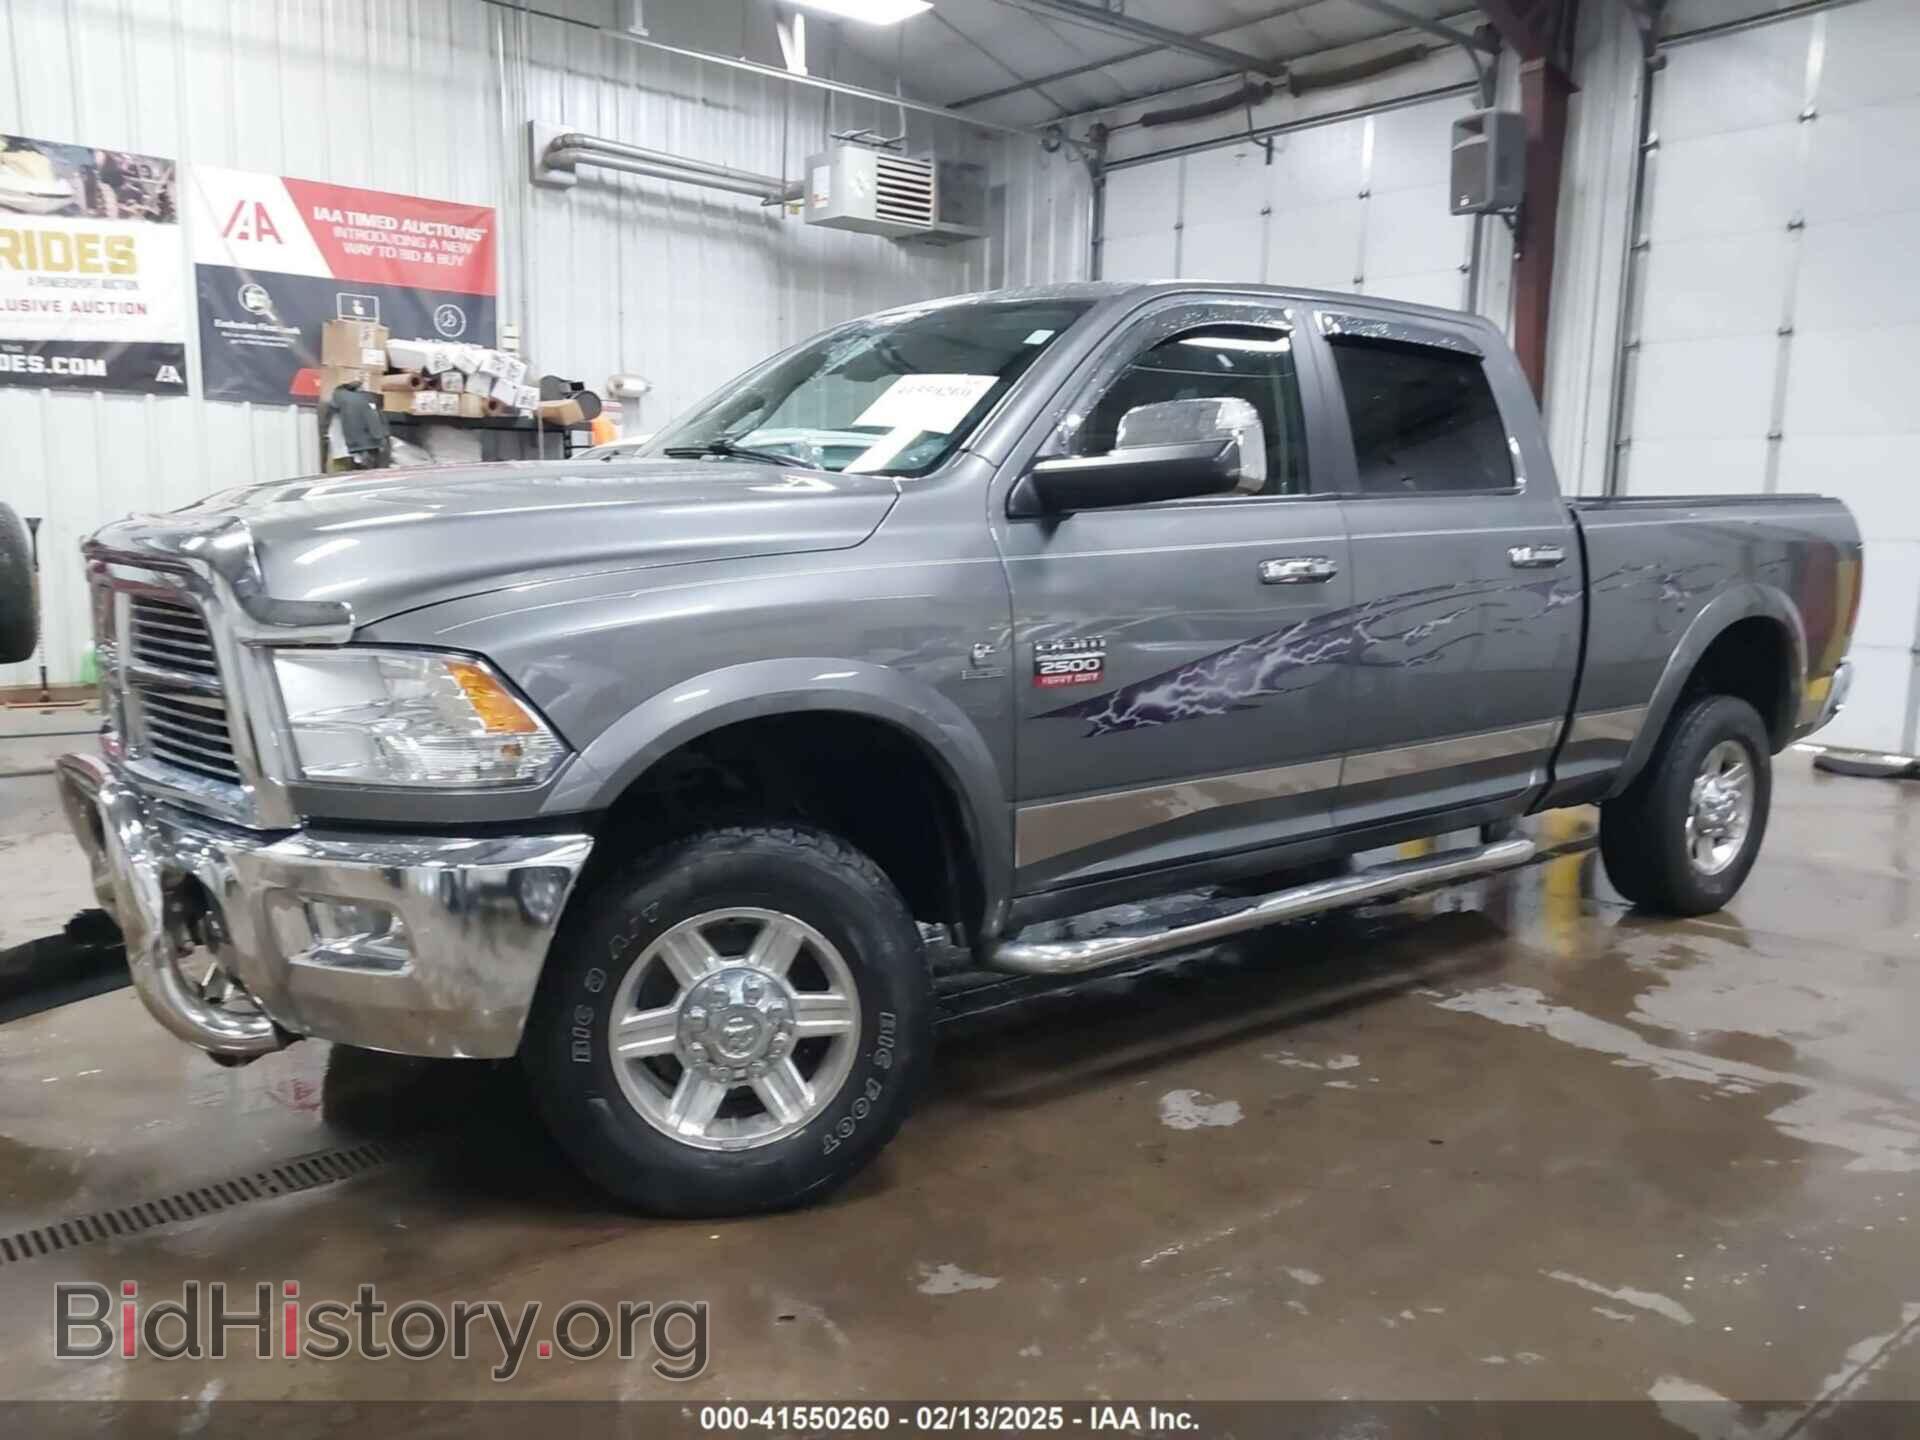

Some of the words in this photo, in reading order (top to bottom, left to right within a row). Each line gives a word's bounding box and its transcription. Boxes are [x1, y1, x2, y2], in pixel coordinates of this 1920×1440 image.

[313, 207, 343, 223] IAA
[345, 211, 398, 230] TIMED
[333, 227, 426, 248] INTRODUCING
[443, 241, 473, 255] NEW
[342, 242, 374, 256] WAY
[378, 246, 396, 258] TO
[400, 248, 420, 262] BID
[437, 253, 465, 266] BUY
[70, 301, 147, 315] AUCTION
[1040, 658, 1100, 674] 2500
